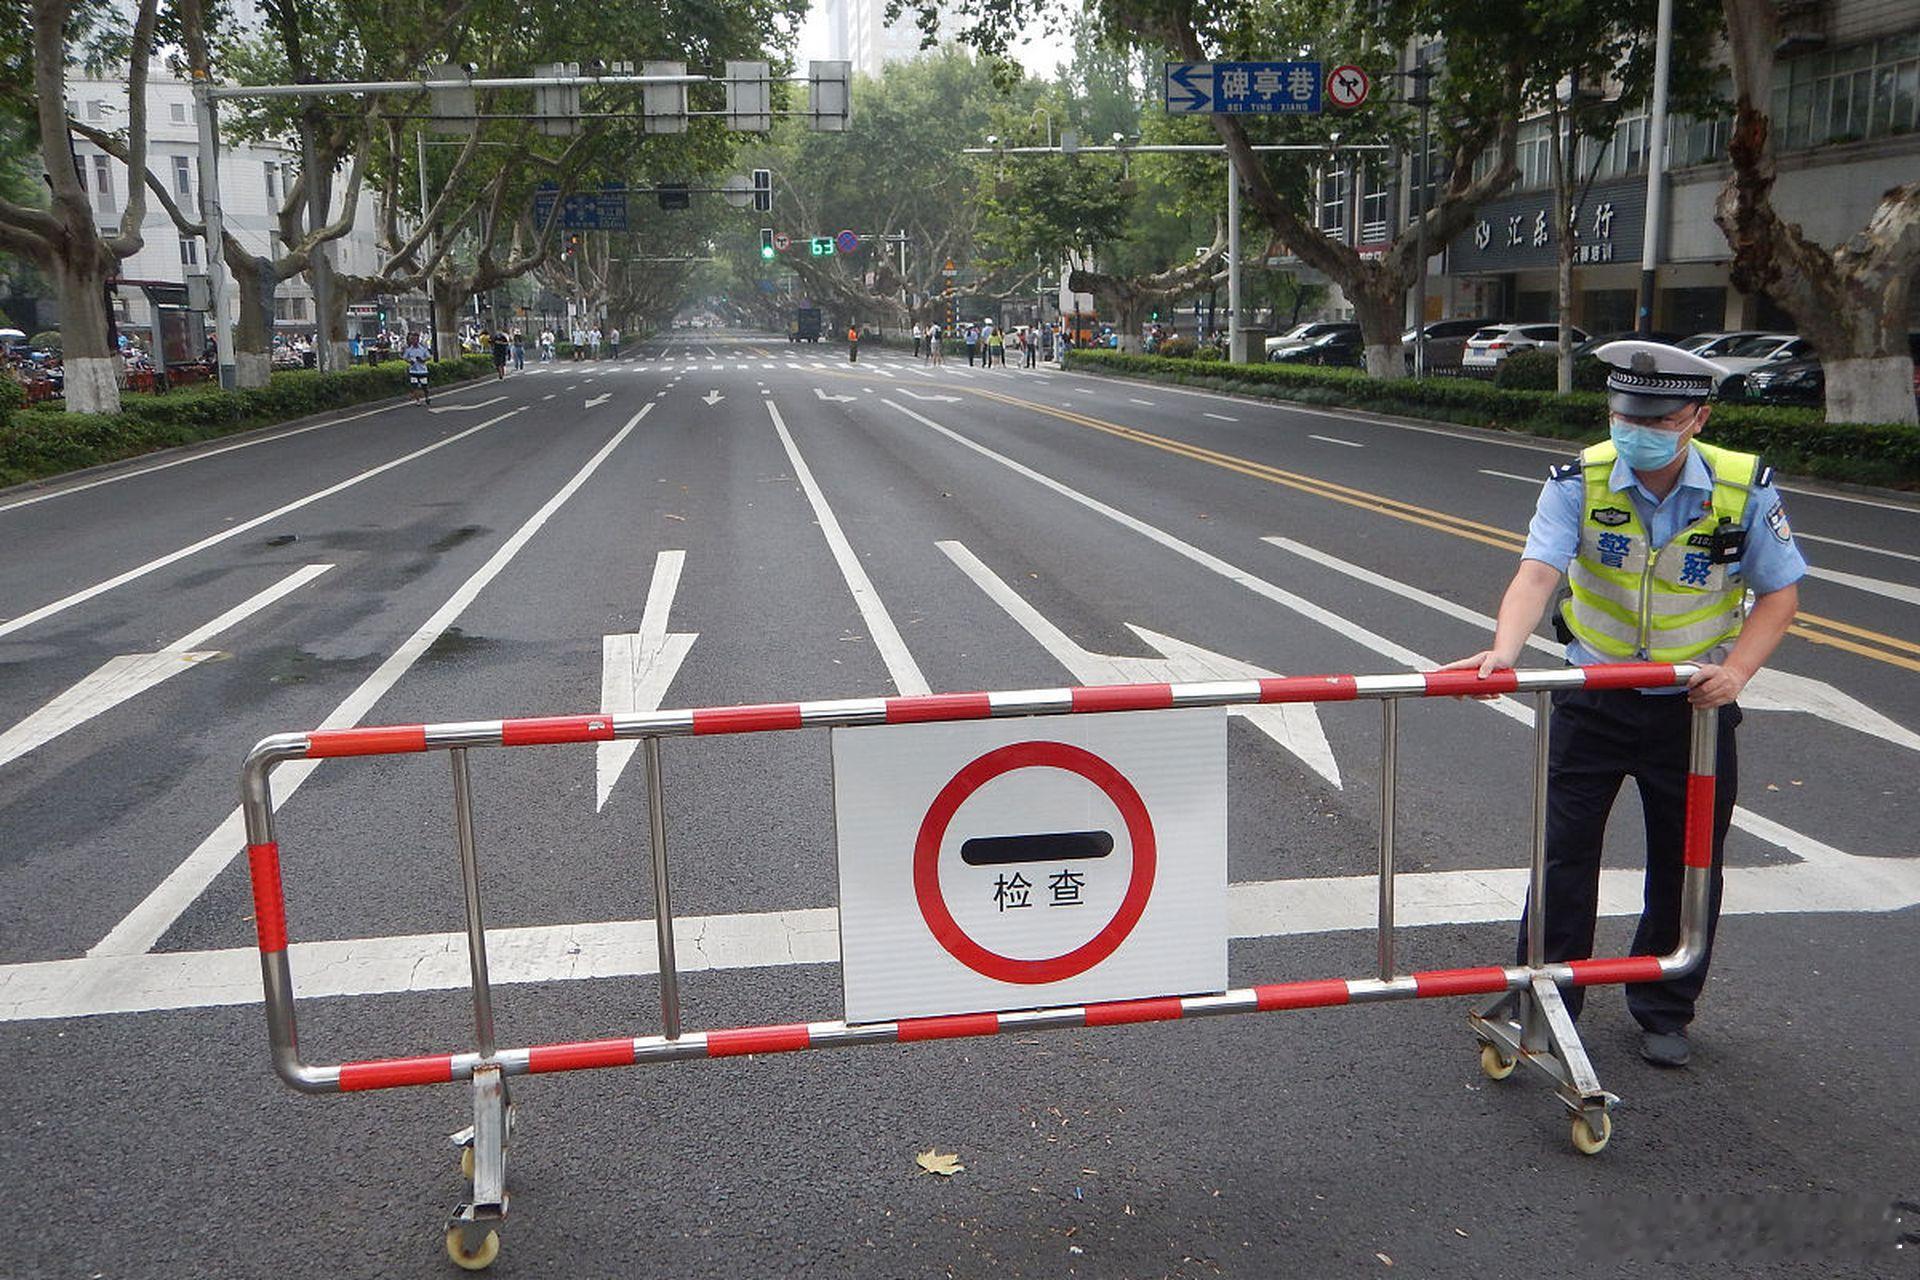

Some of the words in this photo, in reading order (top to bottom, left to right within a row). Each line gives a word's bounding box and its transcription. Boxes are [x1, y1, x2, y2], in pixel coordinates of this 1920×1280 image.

[1222, 67, 1314, 100] 碑亭巷
[1507, 202, 1614, 248] 汇乐行
[811, 236, 835, 256] 63
[993, 868, 1086, 912] 检查
